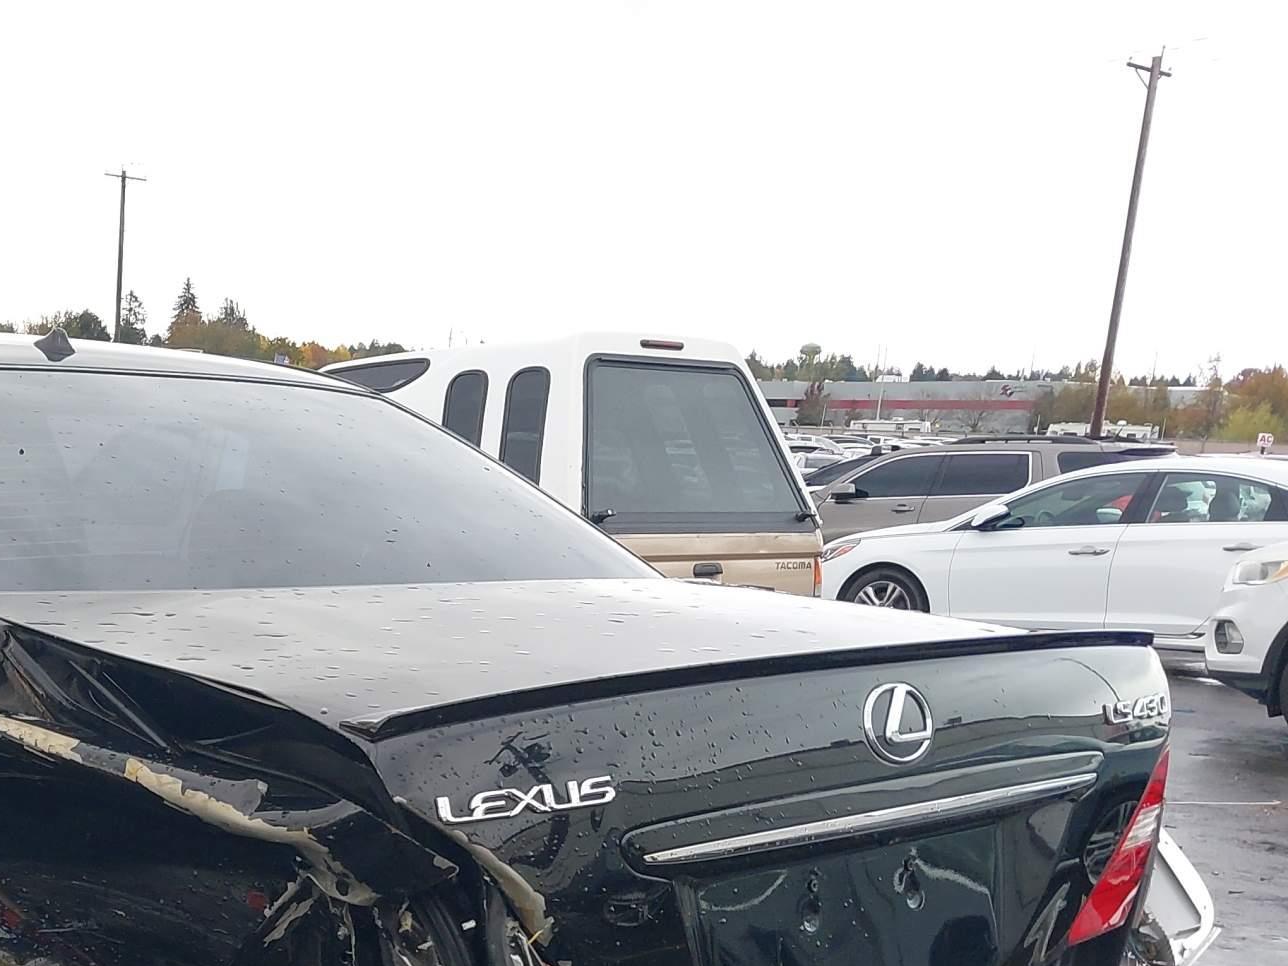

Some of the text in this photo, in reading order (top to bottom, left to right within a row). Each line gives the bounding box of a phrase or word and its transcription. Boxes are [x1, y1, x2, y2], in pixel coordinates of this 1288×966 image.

[775, 561, 812, 570] TACOMA
[1102, 694, 1168, 724] LS 430
[435, 775, 616, 824] LEXUS
